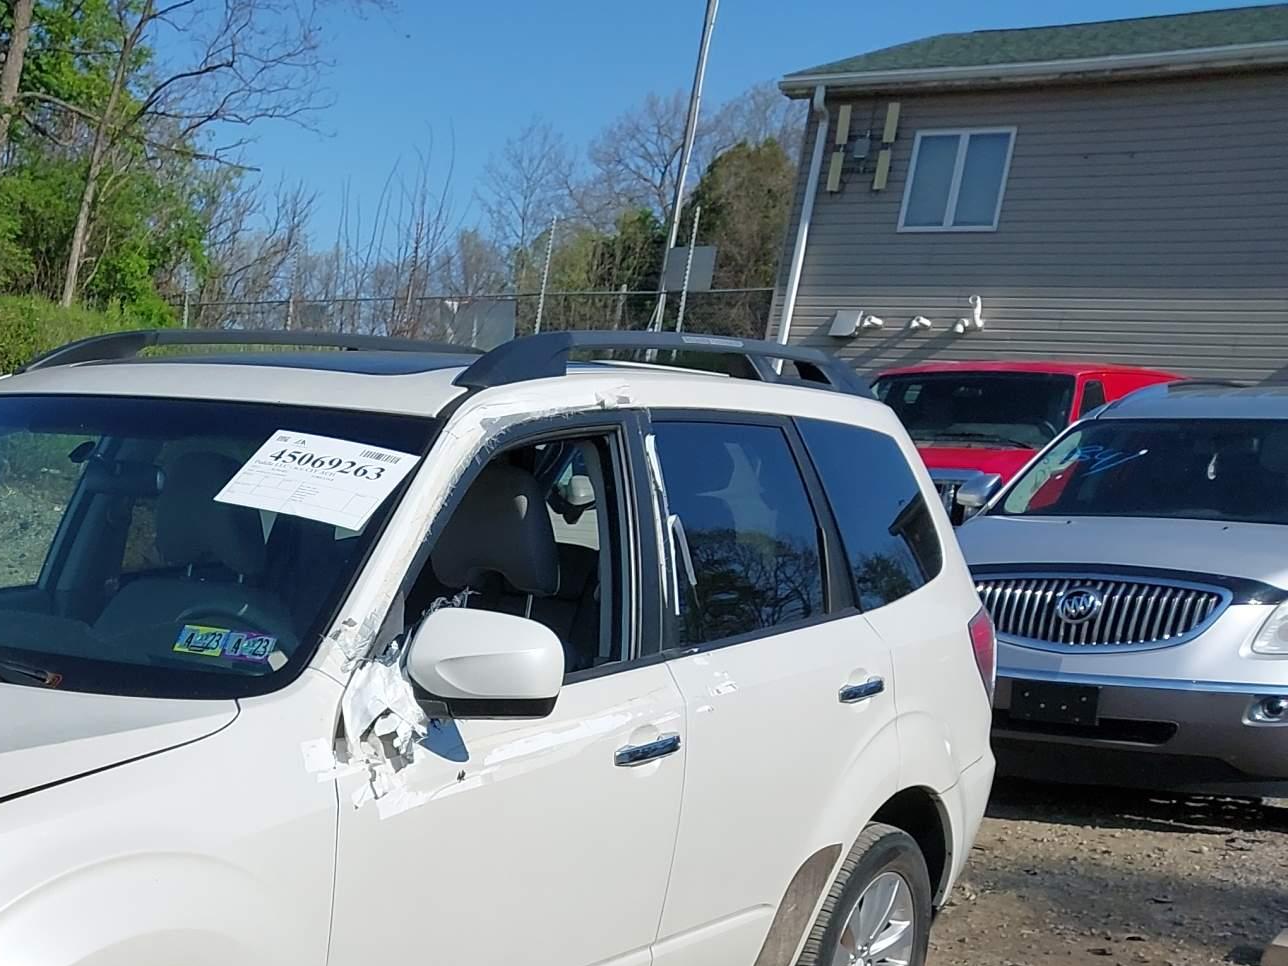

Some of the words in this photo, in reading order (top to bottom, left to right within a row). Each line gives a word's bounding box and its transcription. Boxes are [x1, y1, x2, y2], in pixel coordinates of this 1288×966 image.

[269, 448, 386, 481] 45069263
[184, 632, 195, 649] 4
[207, 632, 222, 650] 23
[232, 638, 242, 654] 4
[252, 638, 270, 657] 23
